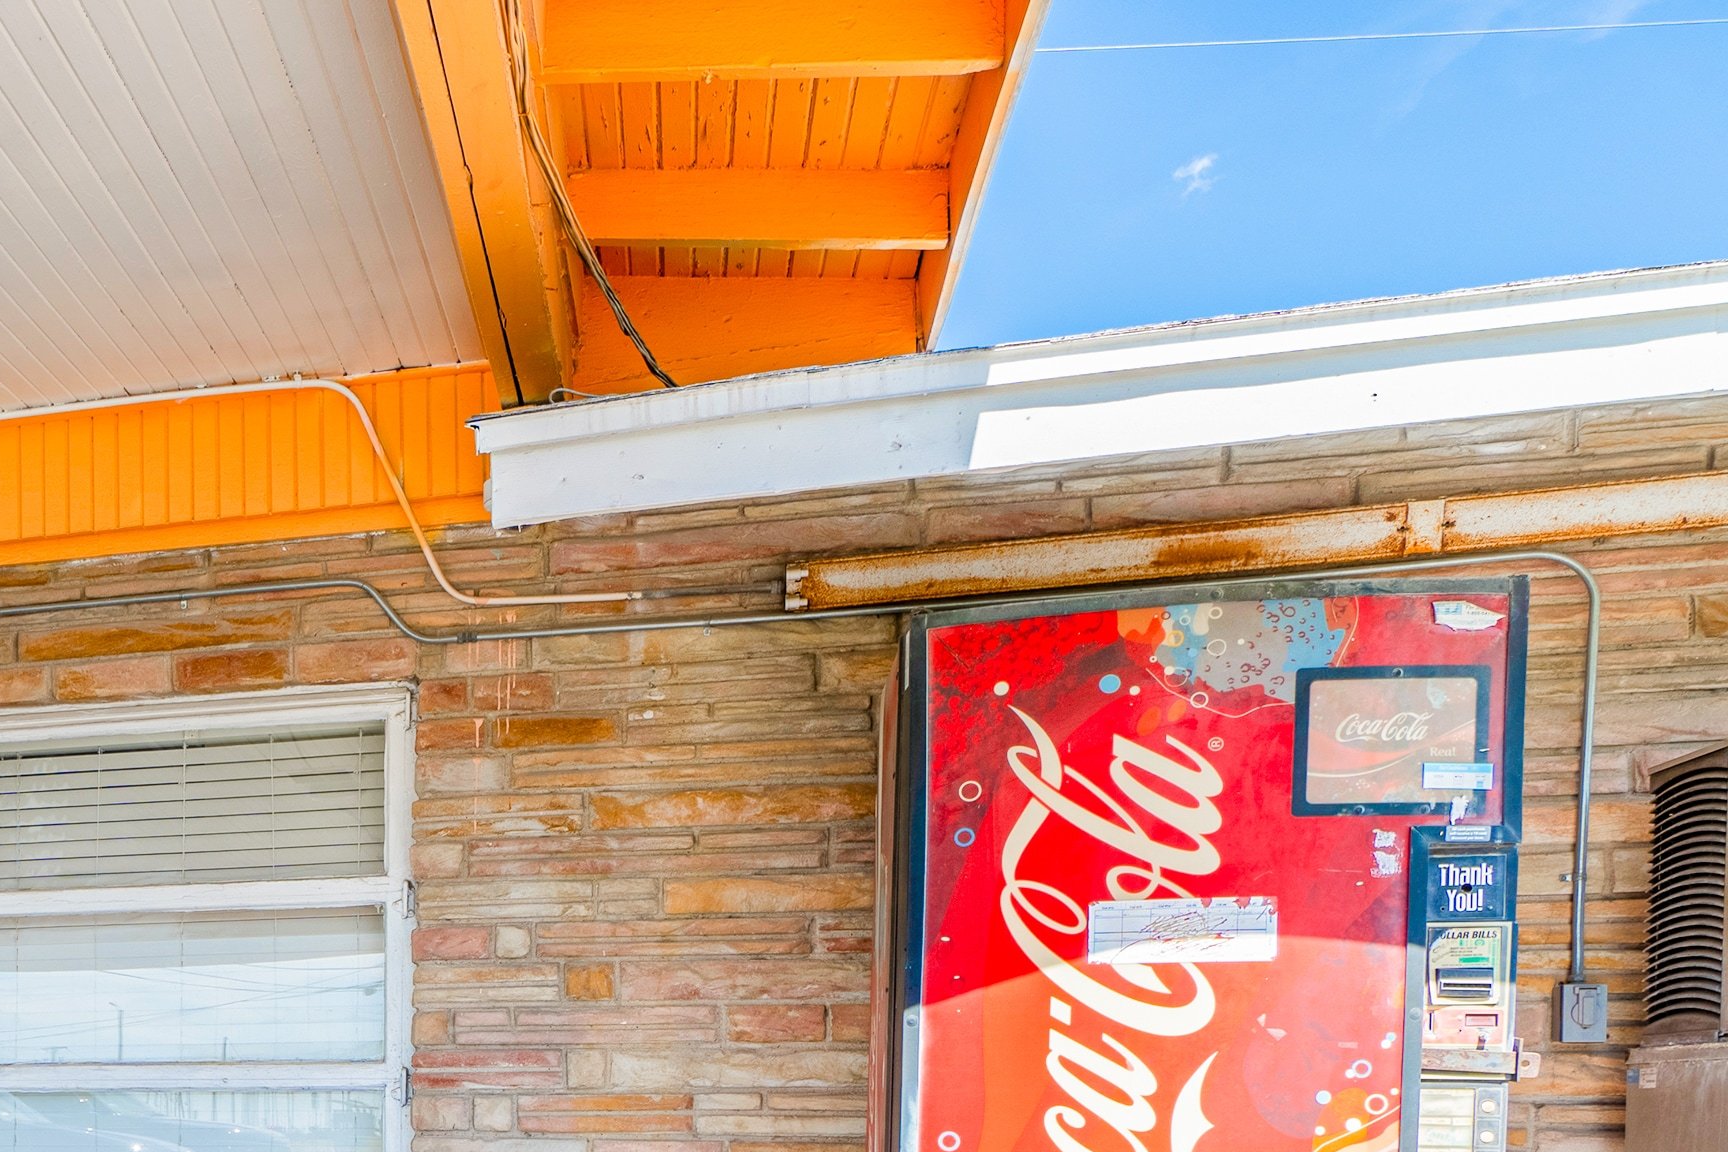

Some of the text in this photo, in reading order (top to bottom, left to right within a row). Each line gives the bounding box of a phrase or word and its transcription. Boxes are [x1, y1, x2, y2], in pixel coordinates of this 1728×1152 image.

[1335, 711, 1434, 743] Coca-Cola
[1429, 746, 1456, 757] Real
[1438, 862, 1493, 887] Thank
[1446, 888, 1484, 912] You!
[1471, 930, 1498, 939] BILLS
